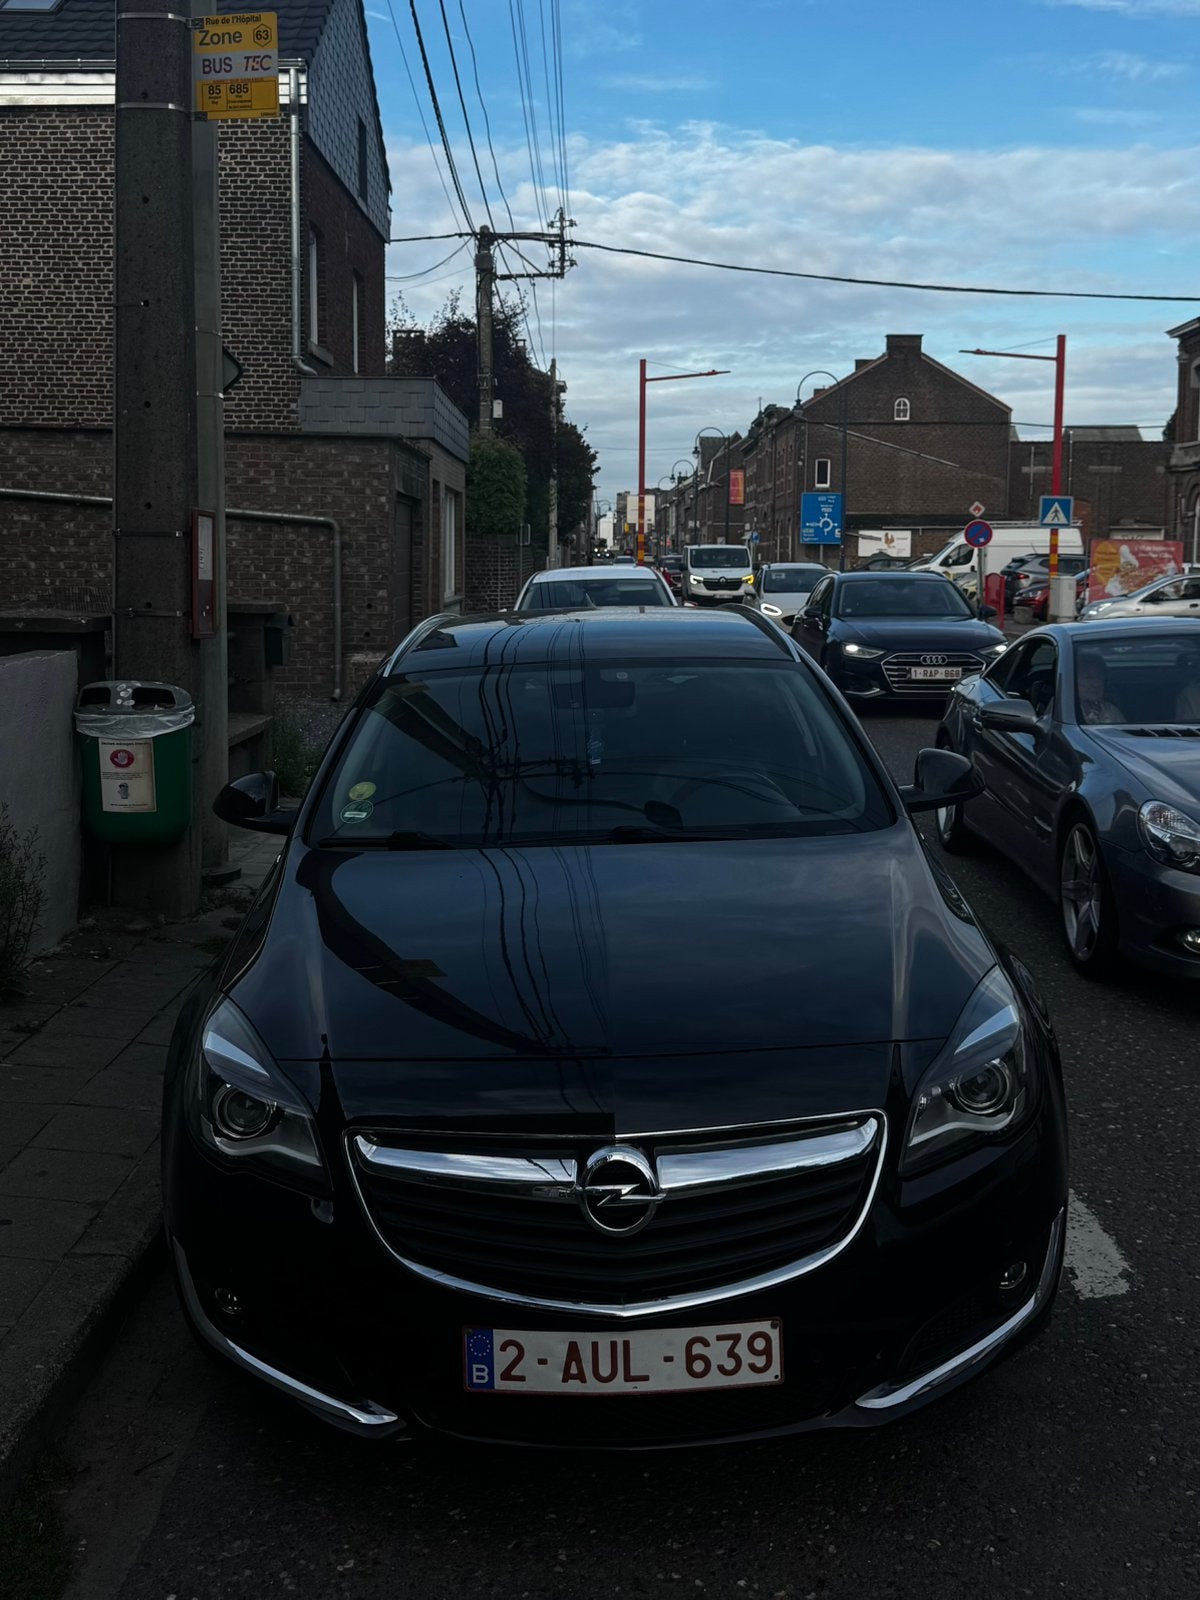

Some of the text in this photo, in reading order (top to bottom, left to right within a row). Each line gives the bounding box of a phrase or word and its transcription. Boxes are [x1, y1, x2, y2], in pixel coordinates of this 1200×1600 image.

[205, 17, 220, 25] Rue
[198, 29, 269, 47] Zone 63
[202, 54, 273, 75] BUS TEC
[208, 84, 222, 96] 85
[229, 83, 249, 95] 685
[472, 1364, 489, 1384] B
